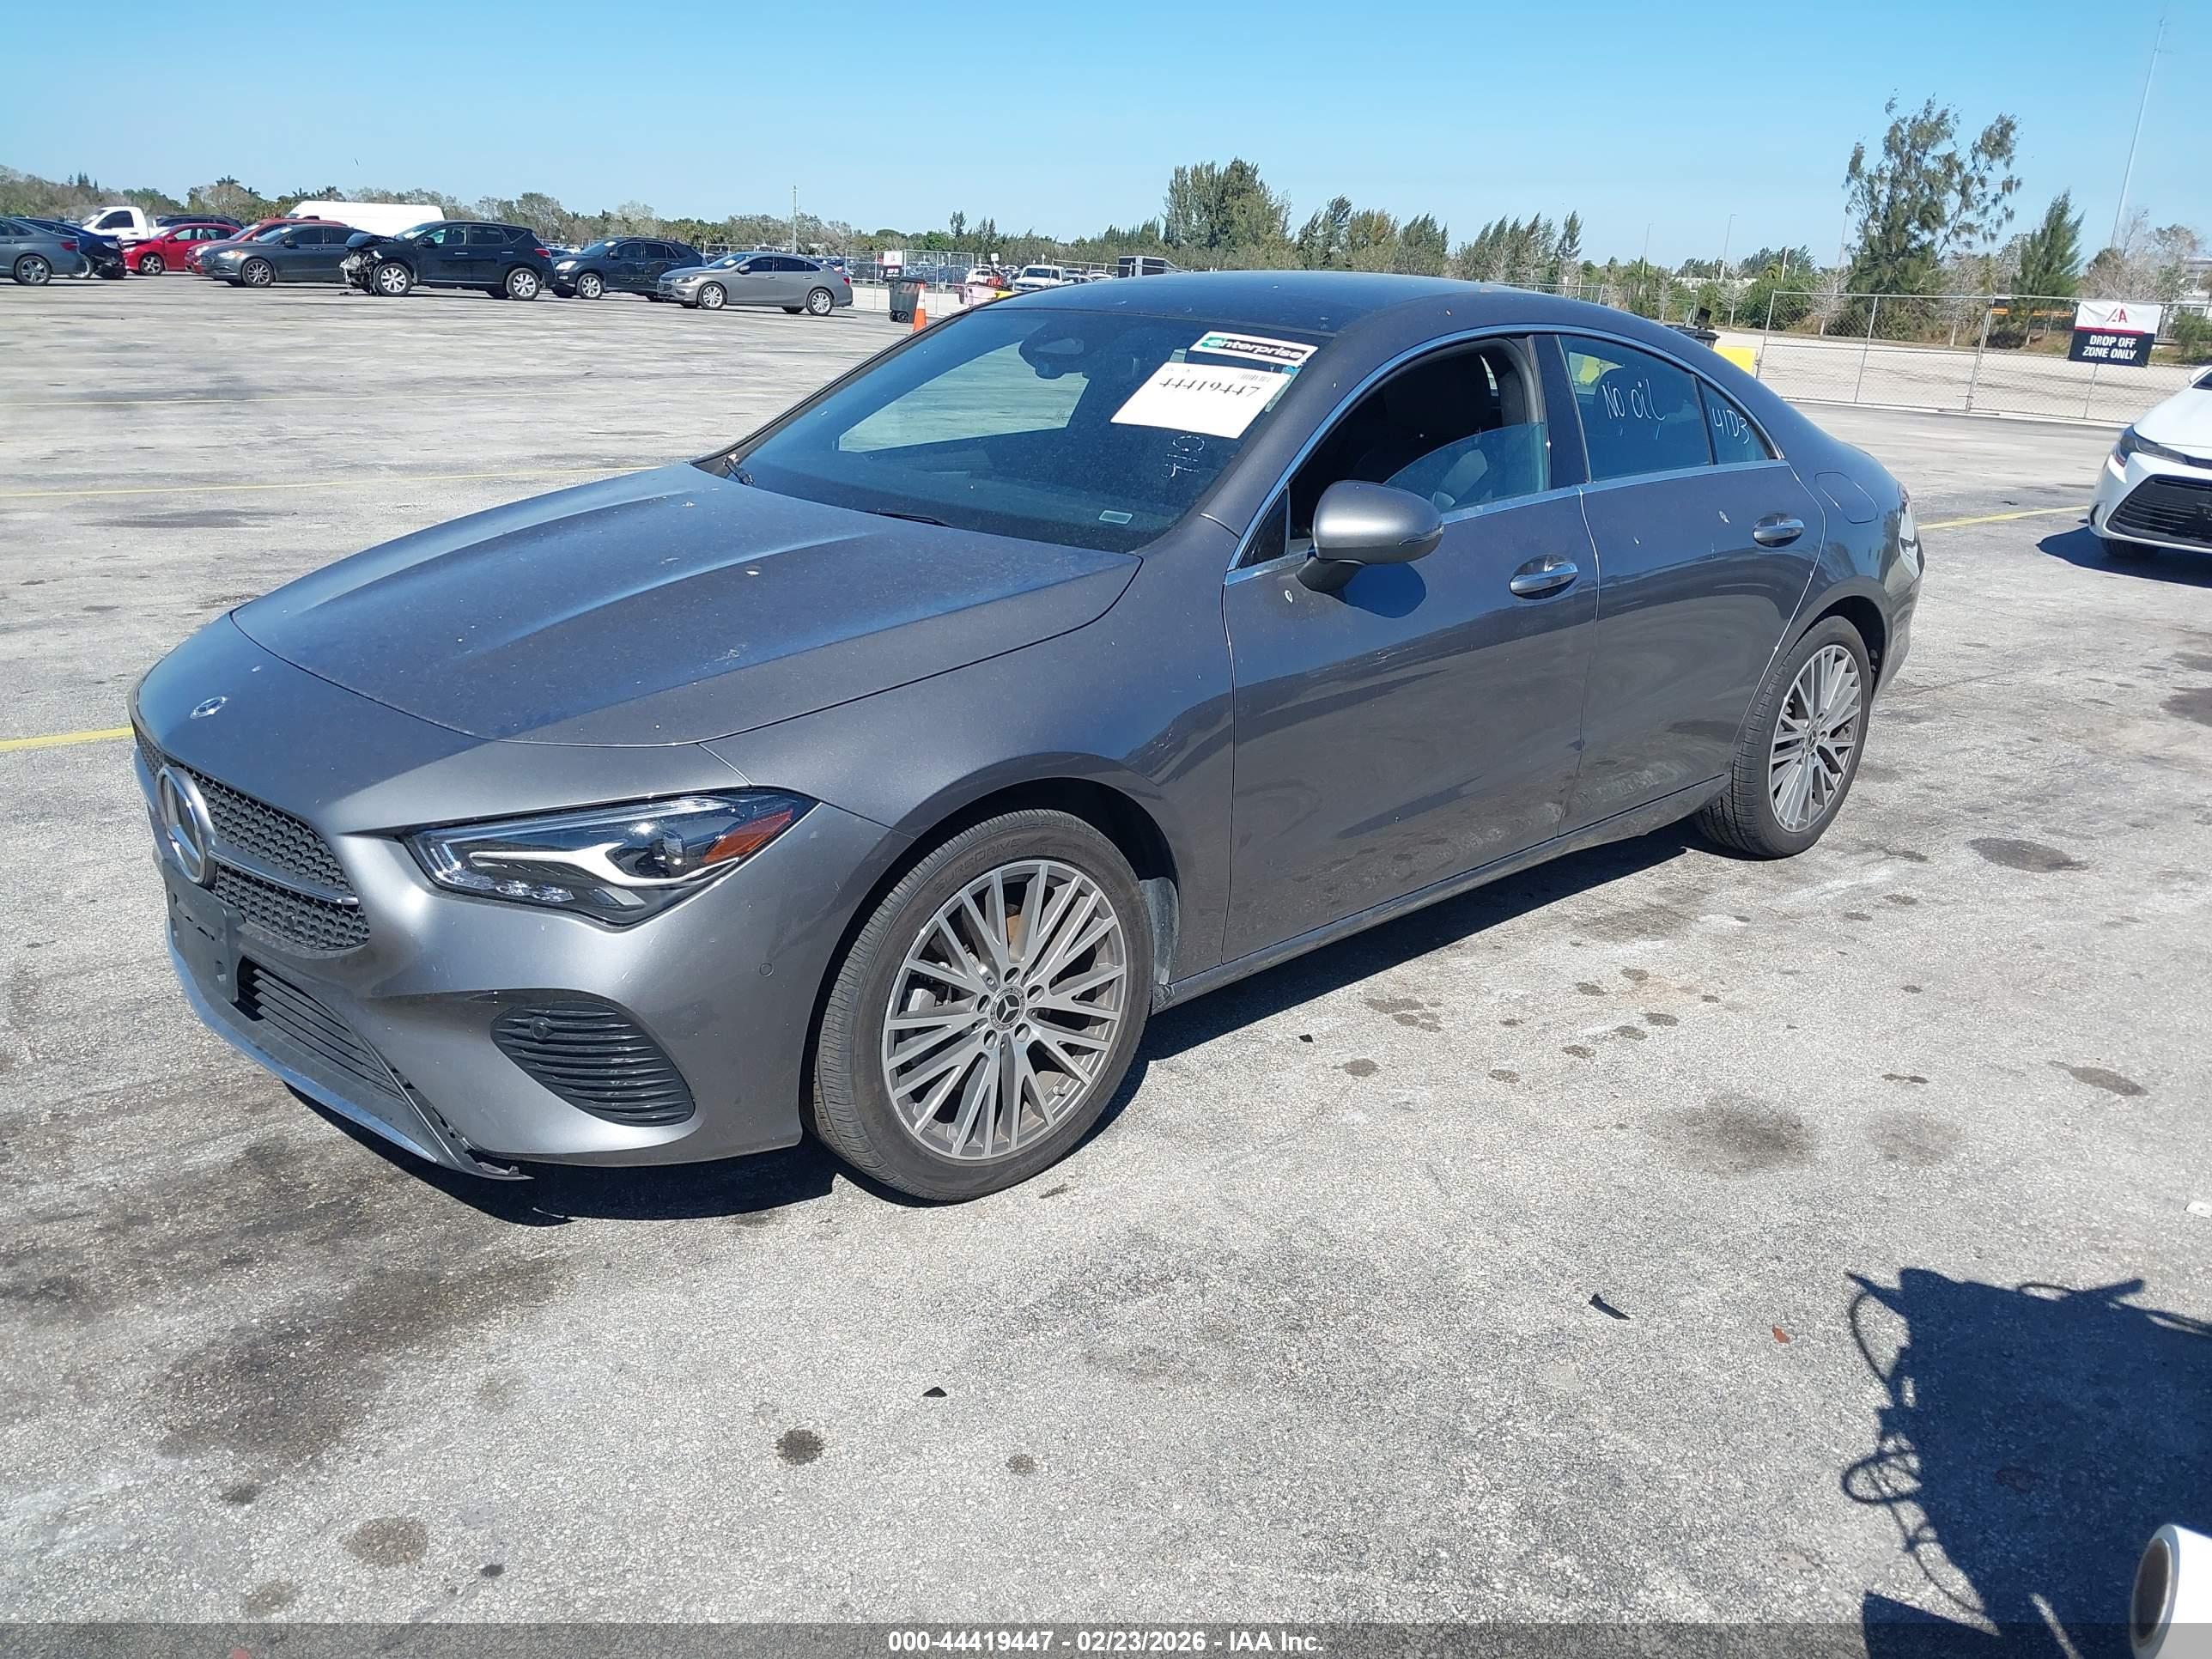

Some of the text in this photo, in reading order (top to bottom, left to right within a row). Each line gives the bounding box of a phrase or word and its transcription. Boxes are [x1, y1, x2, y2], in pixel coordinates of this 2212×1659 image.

[1206, 337, 1304, 359] enterprise
[2090, 335, 2136, 348] DROP OFF
[2082, 347, 2136, 360] ZONE ONLY
